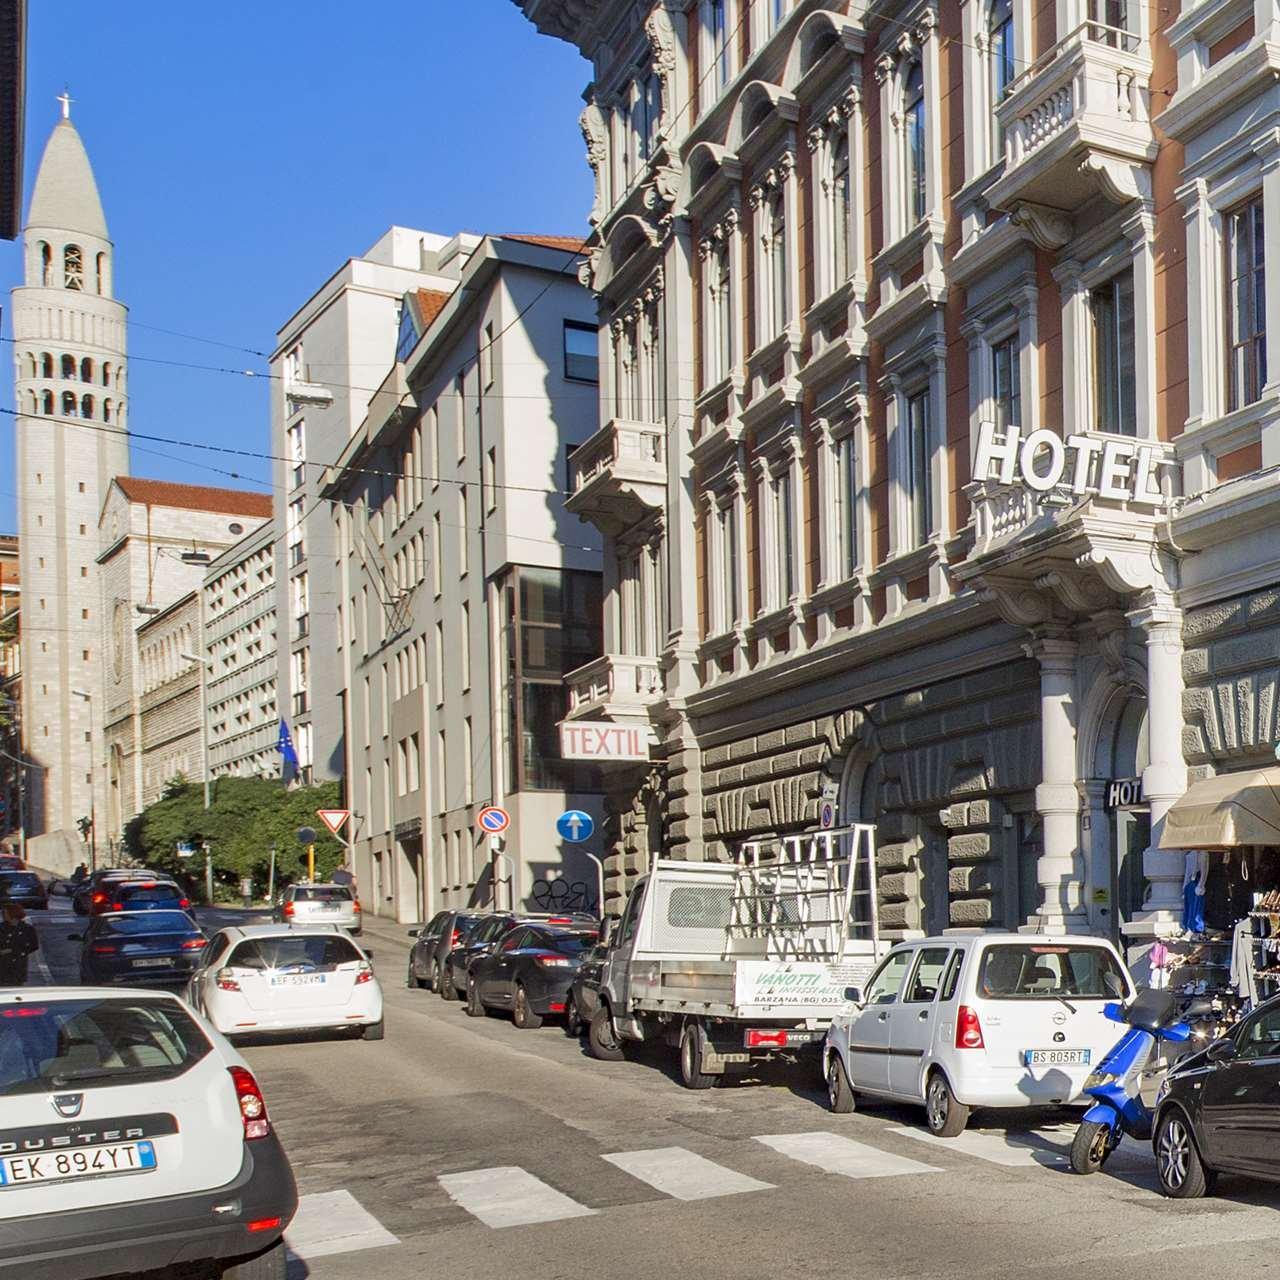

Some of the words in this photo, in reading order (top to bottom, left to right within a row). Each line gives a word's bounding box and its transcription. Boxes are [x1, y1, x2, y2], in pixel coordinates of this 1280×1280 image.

[973, 421, 1165, 505] HOTEL
[564, 727, 646, 756] TEXTIL
[755, 973, 821, 986] VANOTTI
[1033, 1052, 1046, 1063] BS
[1050, 1051, 1082, 1062] 803RT
[0, 1128, 144, 1153] DUSTER
[10, 1157, 44, 1180] EK
[56, 1146, 135, 1175] 894YT
